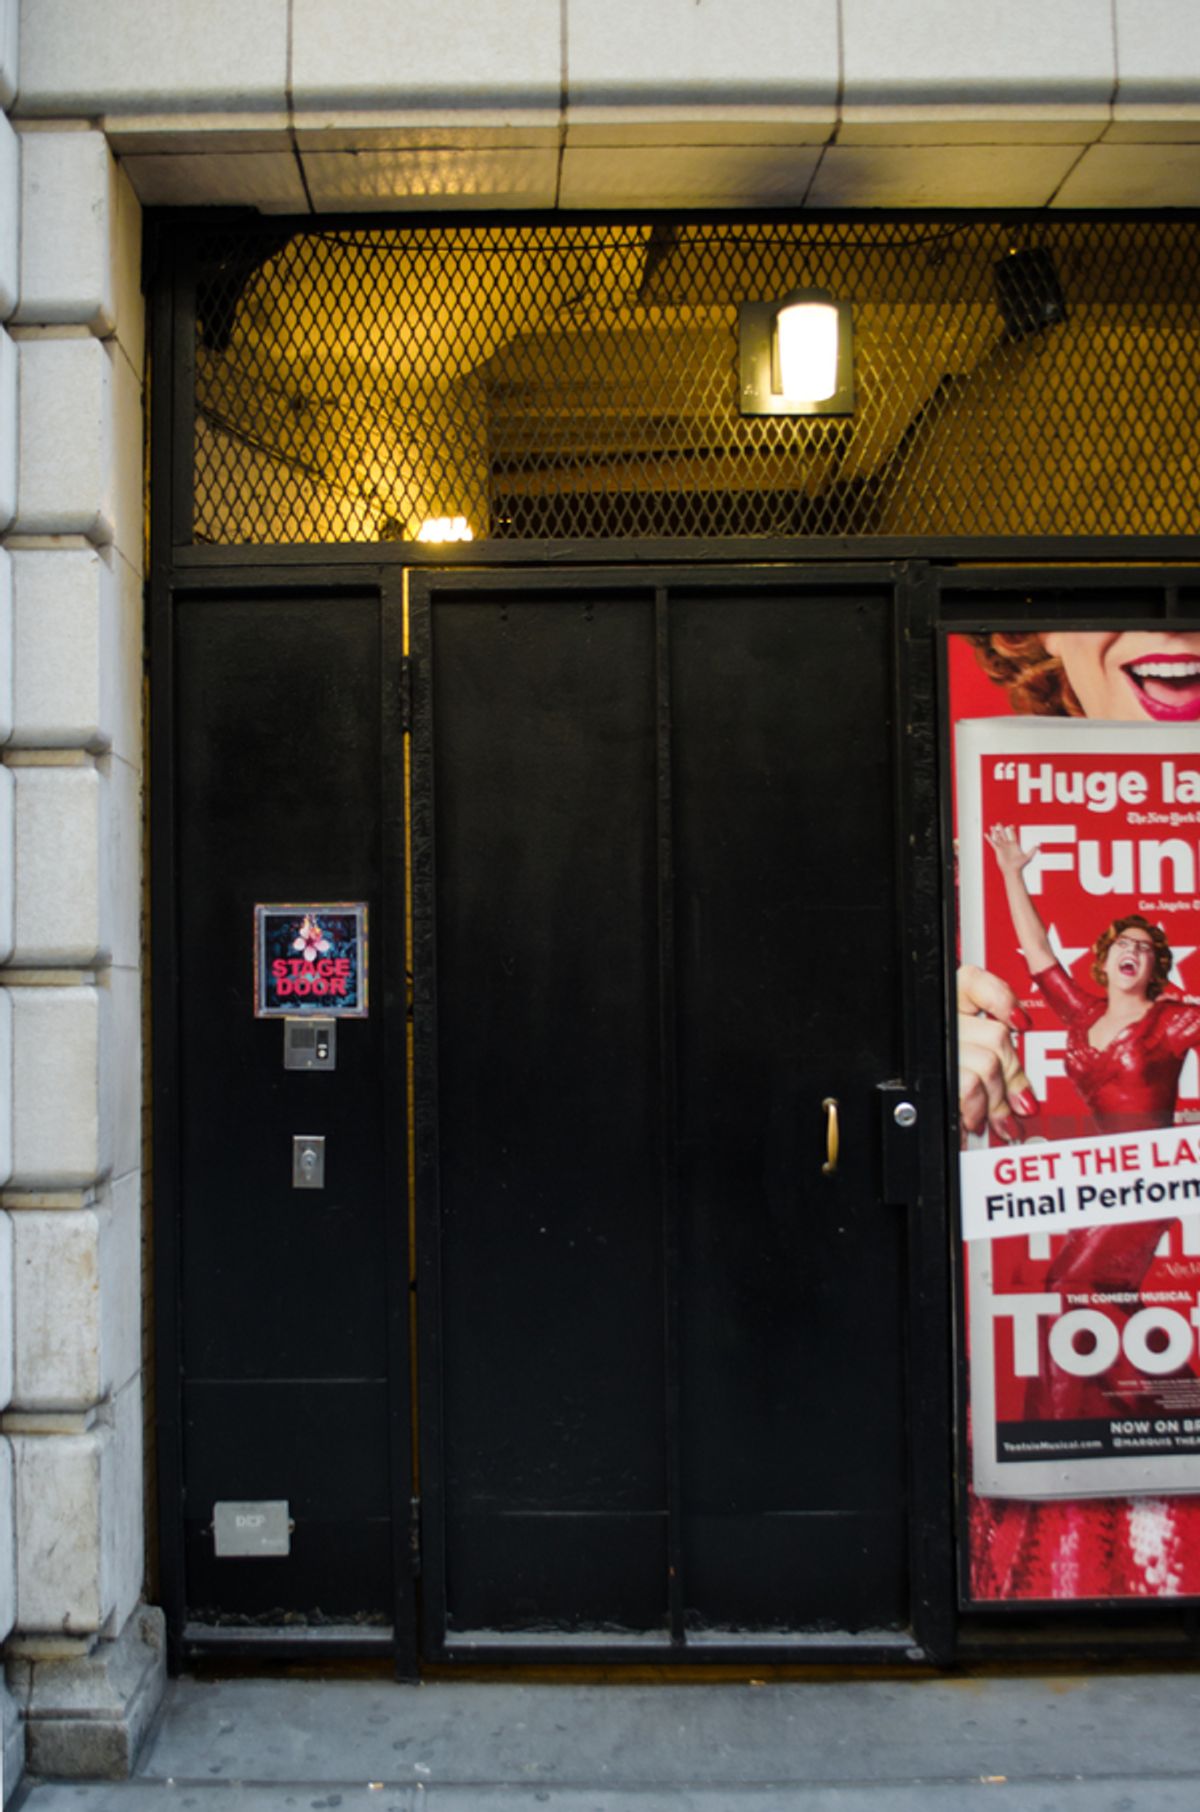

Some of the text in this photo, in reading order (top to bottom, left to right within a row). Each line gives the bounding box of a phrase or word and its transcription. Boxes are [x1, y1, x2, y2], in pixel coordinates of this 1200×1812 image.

[1019, 824, 1200, 895] Fun
[271, 958, 351, 979] STAGE
[276, 977, 347, 996] DOOR
[993, 1137, 1200, 1185] GET THE LA
[985, 1187, 1066, 1221] Final
[1066, 1290, 1192, 1305] THE COMEDY MUSICAL
[993, 1291, 1200, 1379] Too
[1109, 1421, 1150, 1434] NOW
[1154, 1420, 1179, 1433] ON
